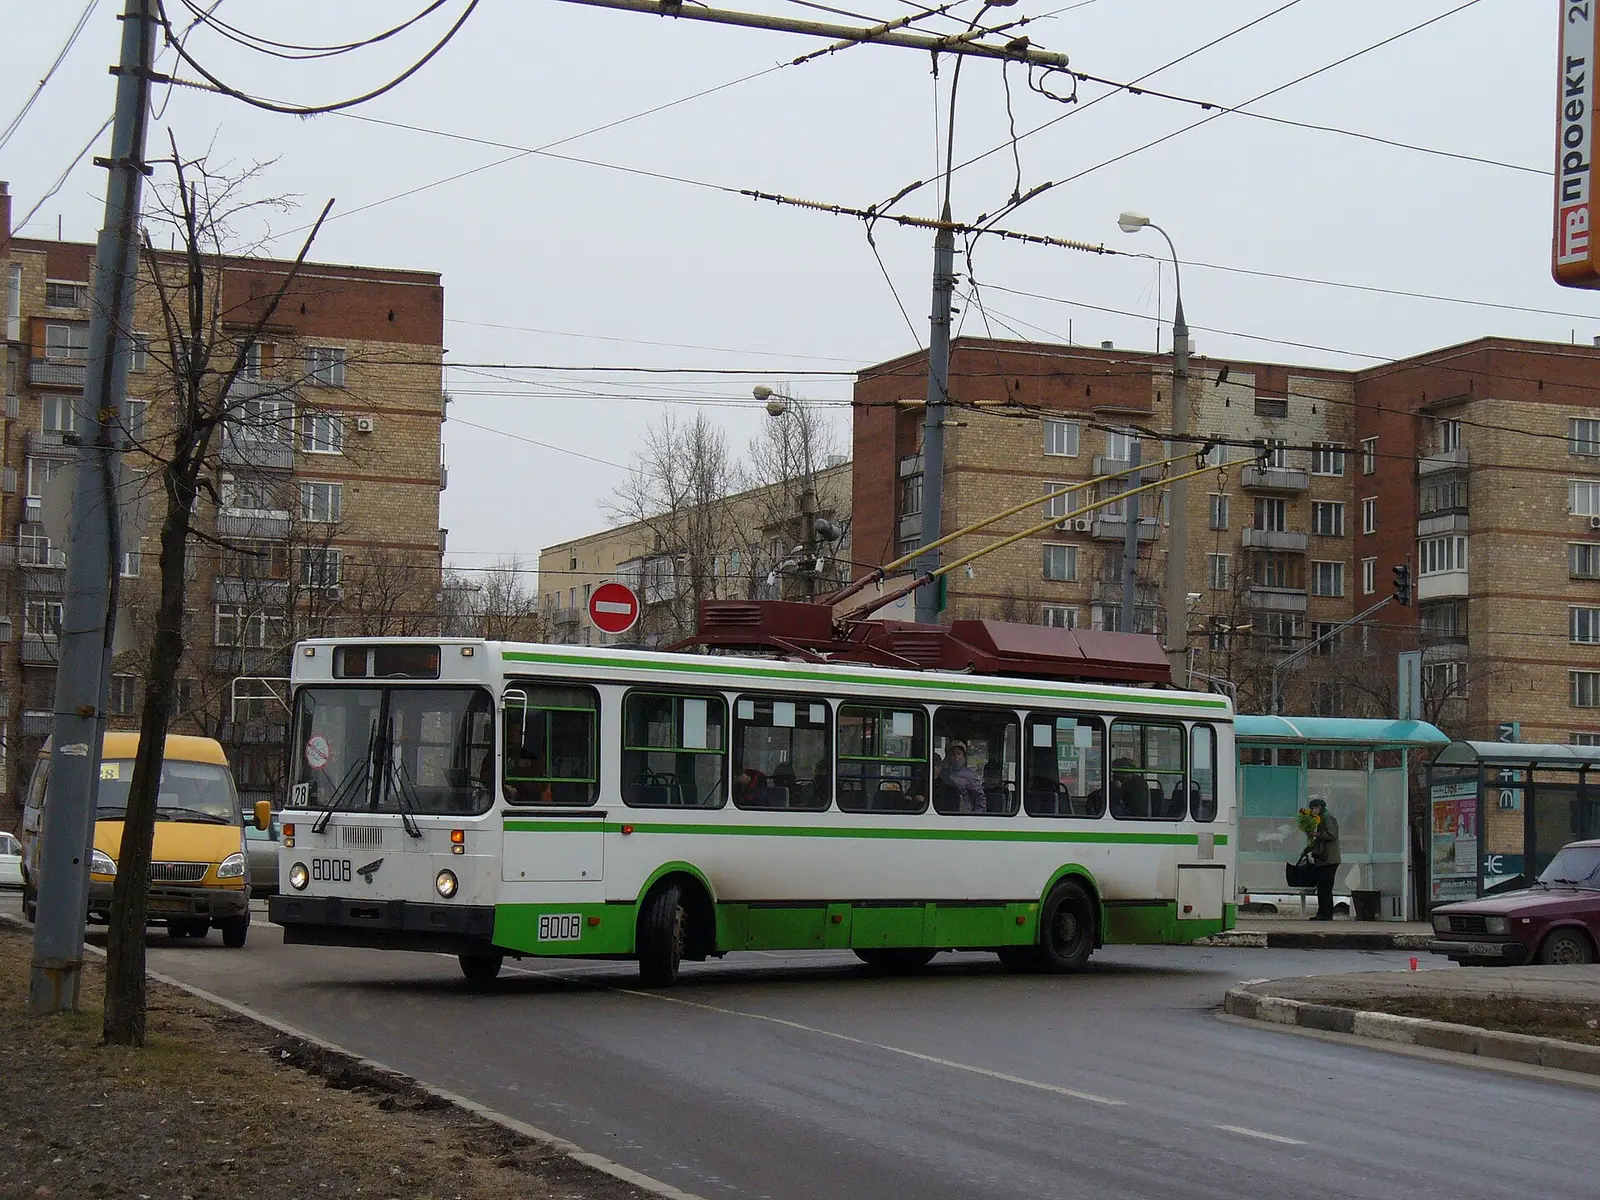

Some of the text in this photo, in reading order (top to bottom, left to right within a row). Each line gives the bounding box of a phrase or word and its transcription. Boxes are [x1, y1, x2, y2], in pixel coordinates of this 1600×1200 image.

[1568, 0, 1588, 24] 2
[1562, 56, 1590, 201] проект
[295, 786, 307, 806] 28
[312, 858, 351, 882] 8008
[539, 915, 580, 939] 8008
